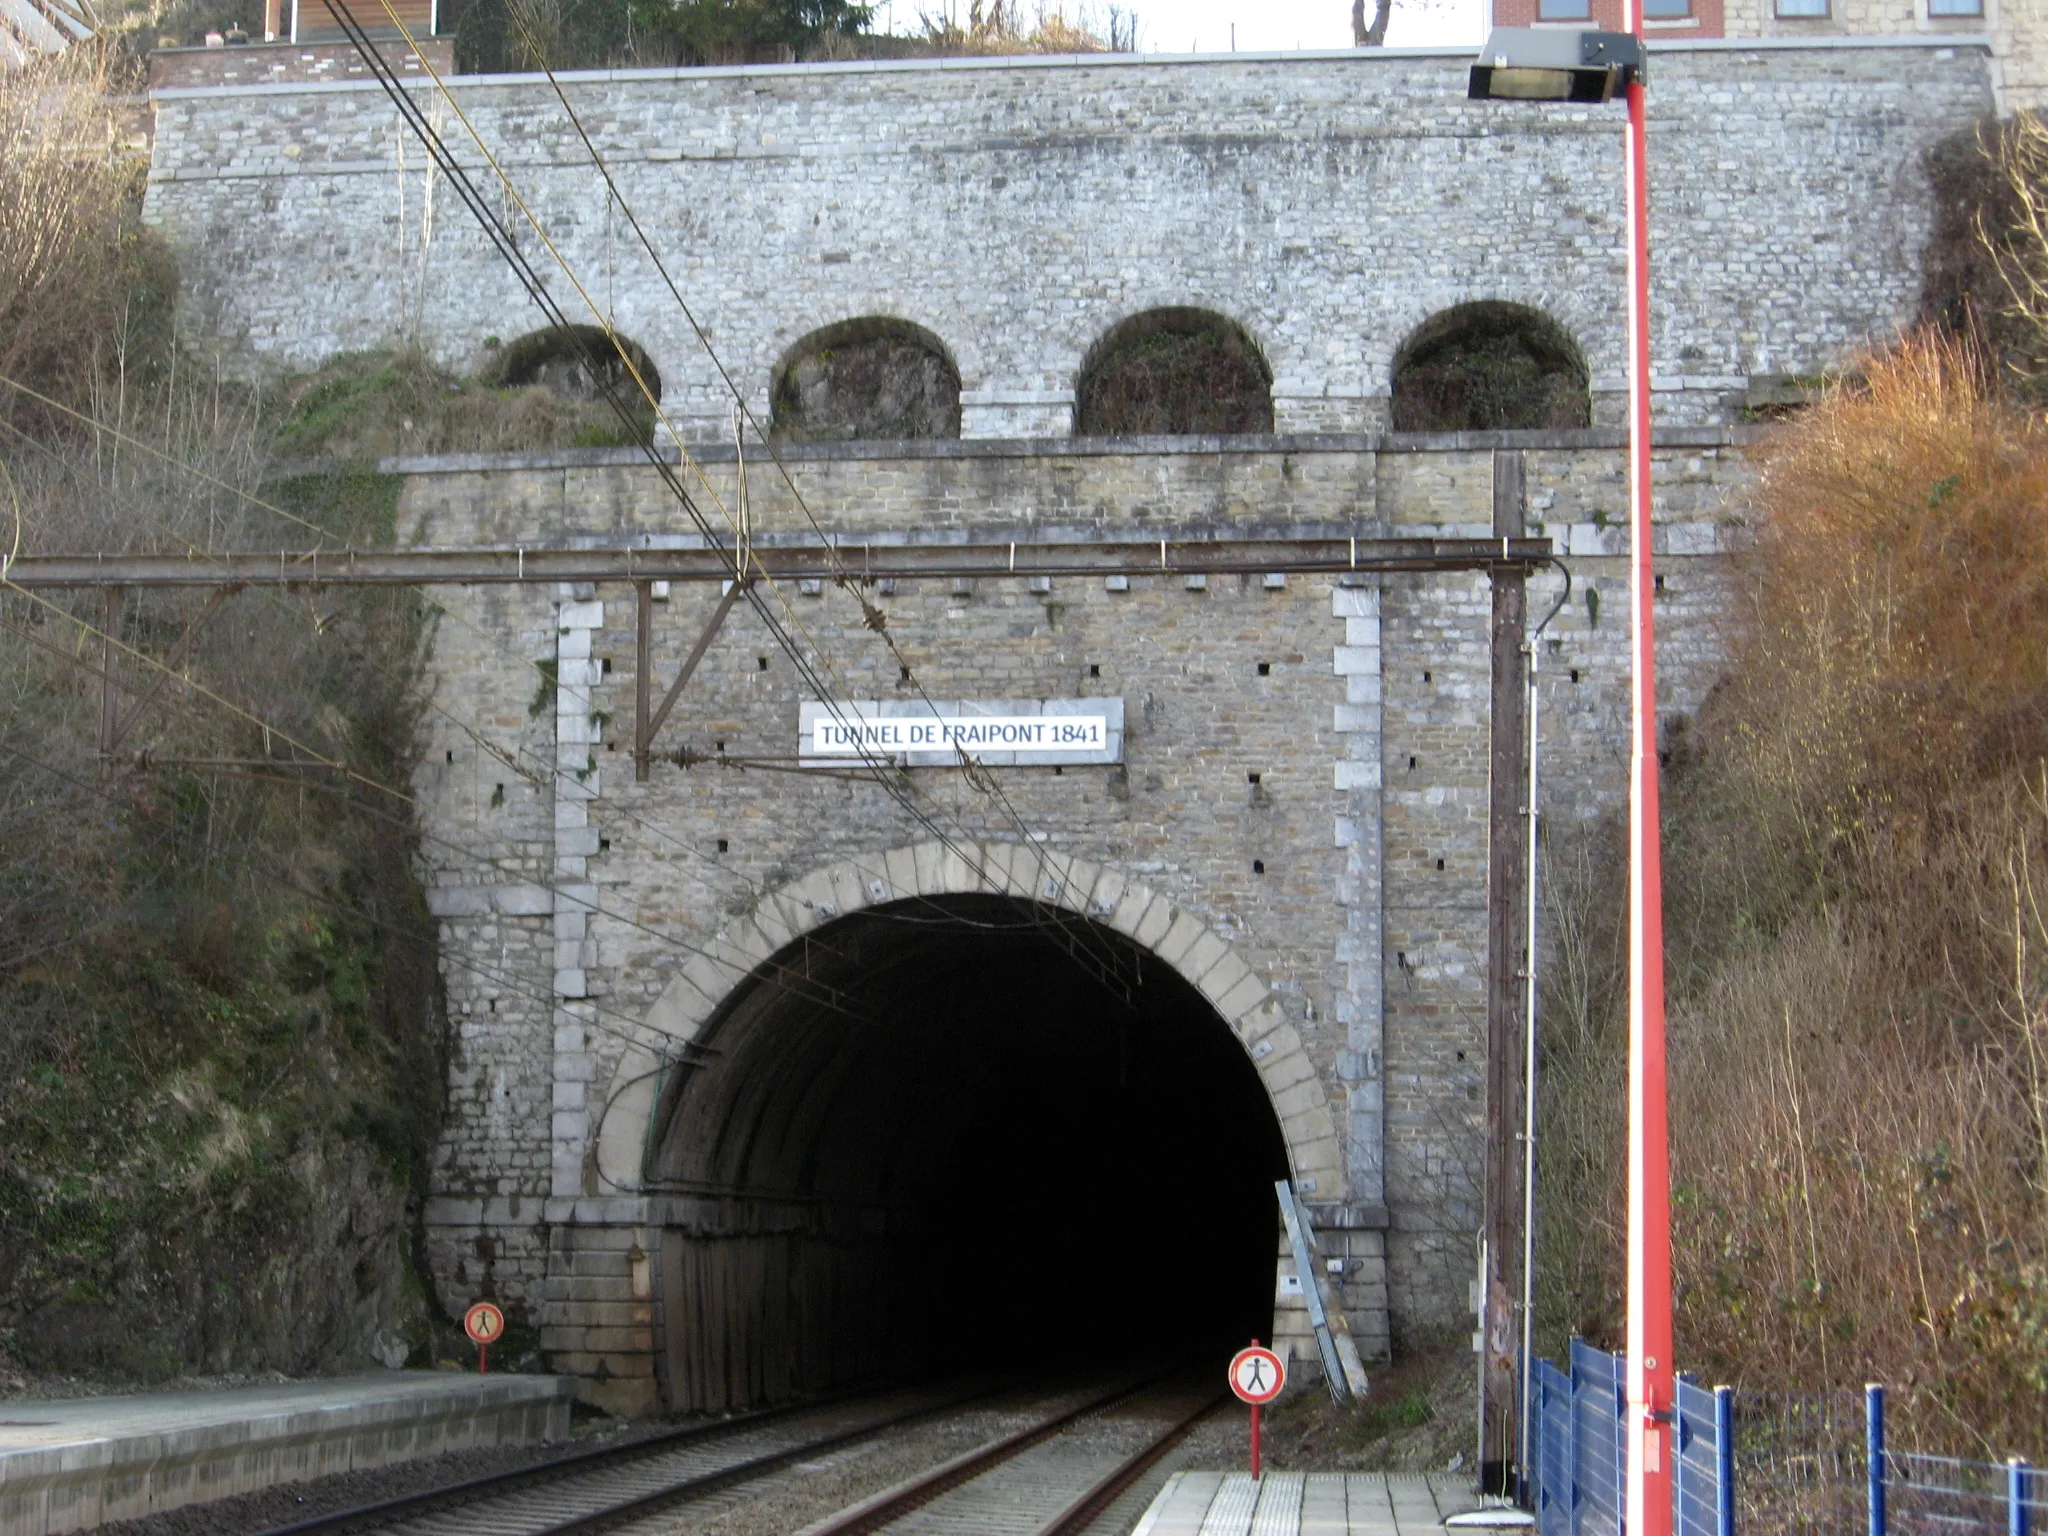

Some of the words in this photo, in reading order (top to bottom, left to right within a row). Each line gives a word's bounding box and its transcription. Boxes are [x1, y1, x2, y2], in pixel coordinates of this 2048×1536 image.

[821, 725, 903, 744] TUNNEL
[910, 725, 935, 743] DE
[943, 724, 1046, 743] FRAIPONT
[1051, 724, 1099, 742] 1841
